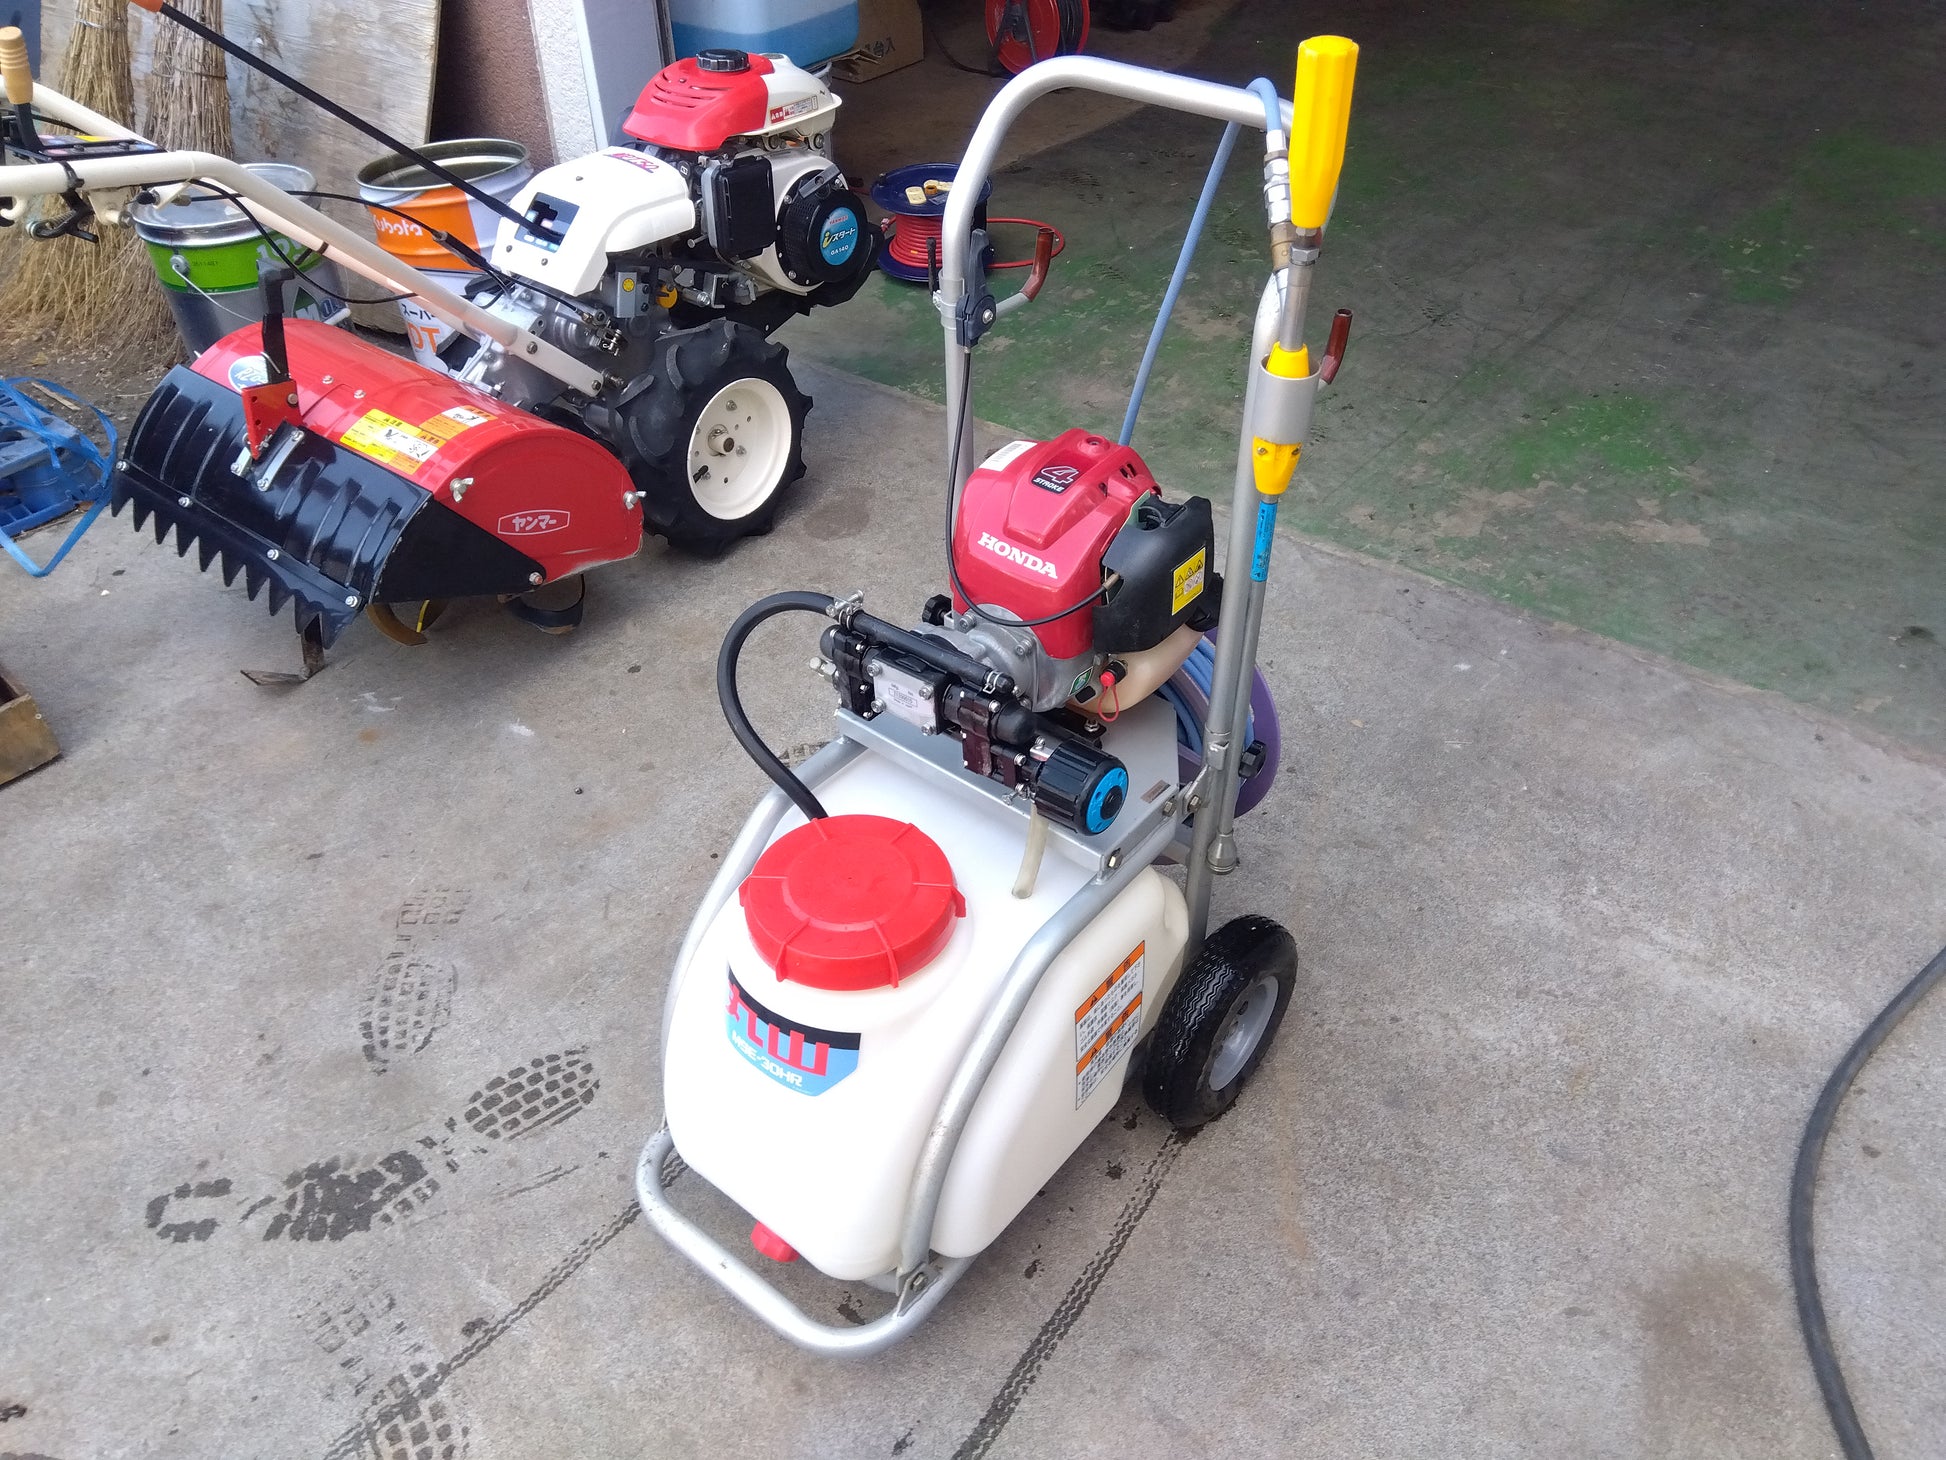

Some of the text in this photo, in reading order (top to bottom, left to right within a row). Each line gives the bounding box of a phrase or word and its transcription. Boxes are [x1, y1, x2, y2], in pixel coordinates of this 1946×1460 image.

[1040, 465, 1080, 484] 4
[1033, 477, 1065, 493] STROKE
[511, 515, 557, 532] ヤンマー
[977, 531, 1058, 580] HONDA
